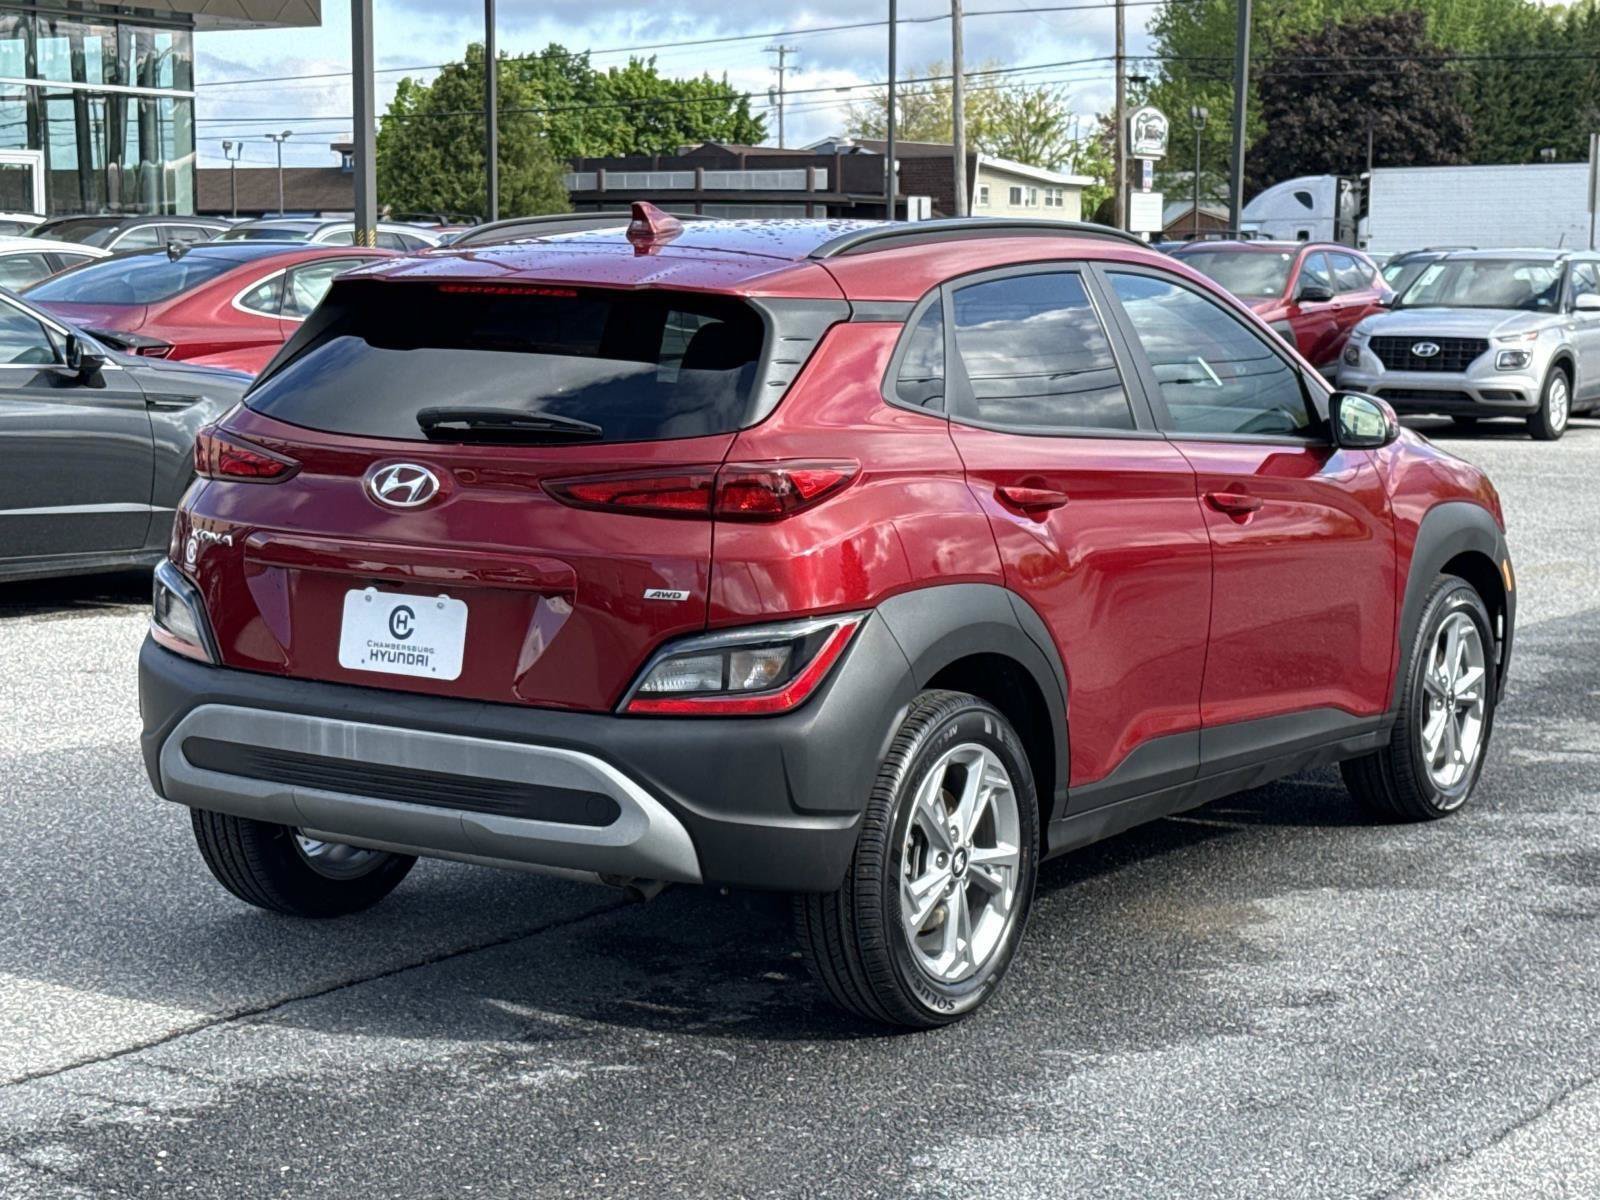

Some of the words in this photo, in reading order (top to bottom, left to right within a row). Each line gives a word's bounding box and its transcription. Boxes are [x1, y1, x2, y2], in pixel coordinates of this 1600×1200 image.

[649, 591, 682, 599] AWD
[369, 649, 430, 667] HYUNDAI
[913, 978, 957, 1010] SOLUS
